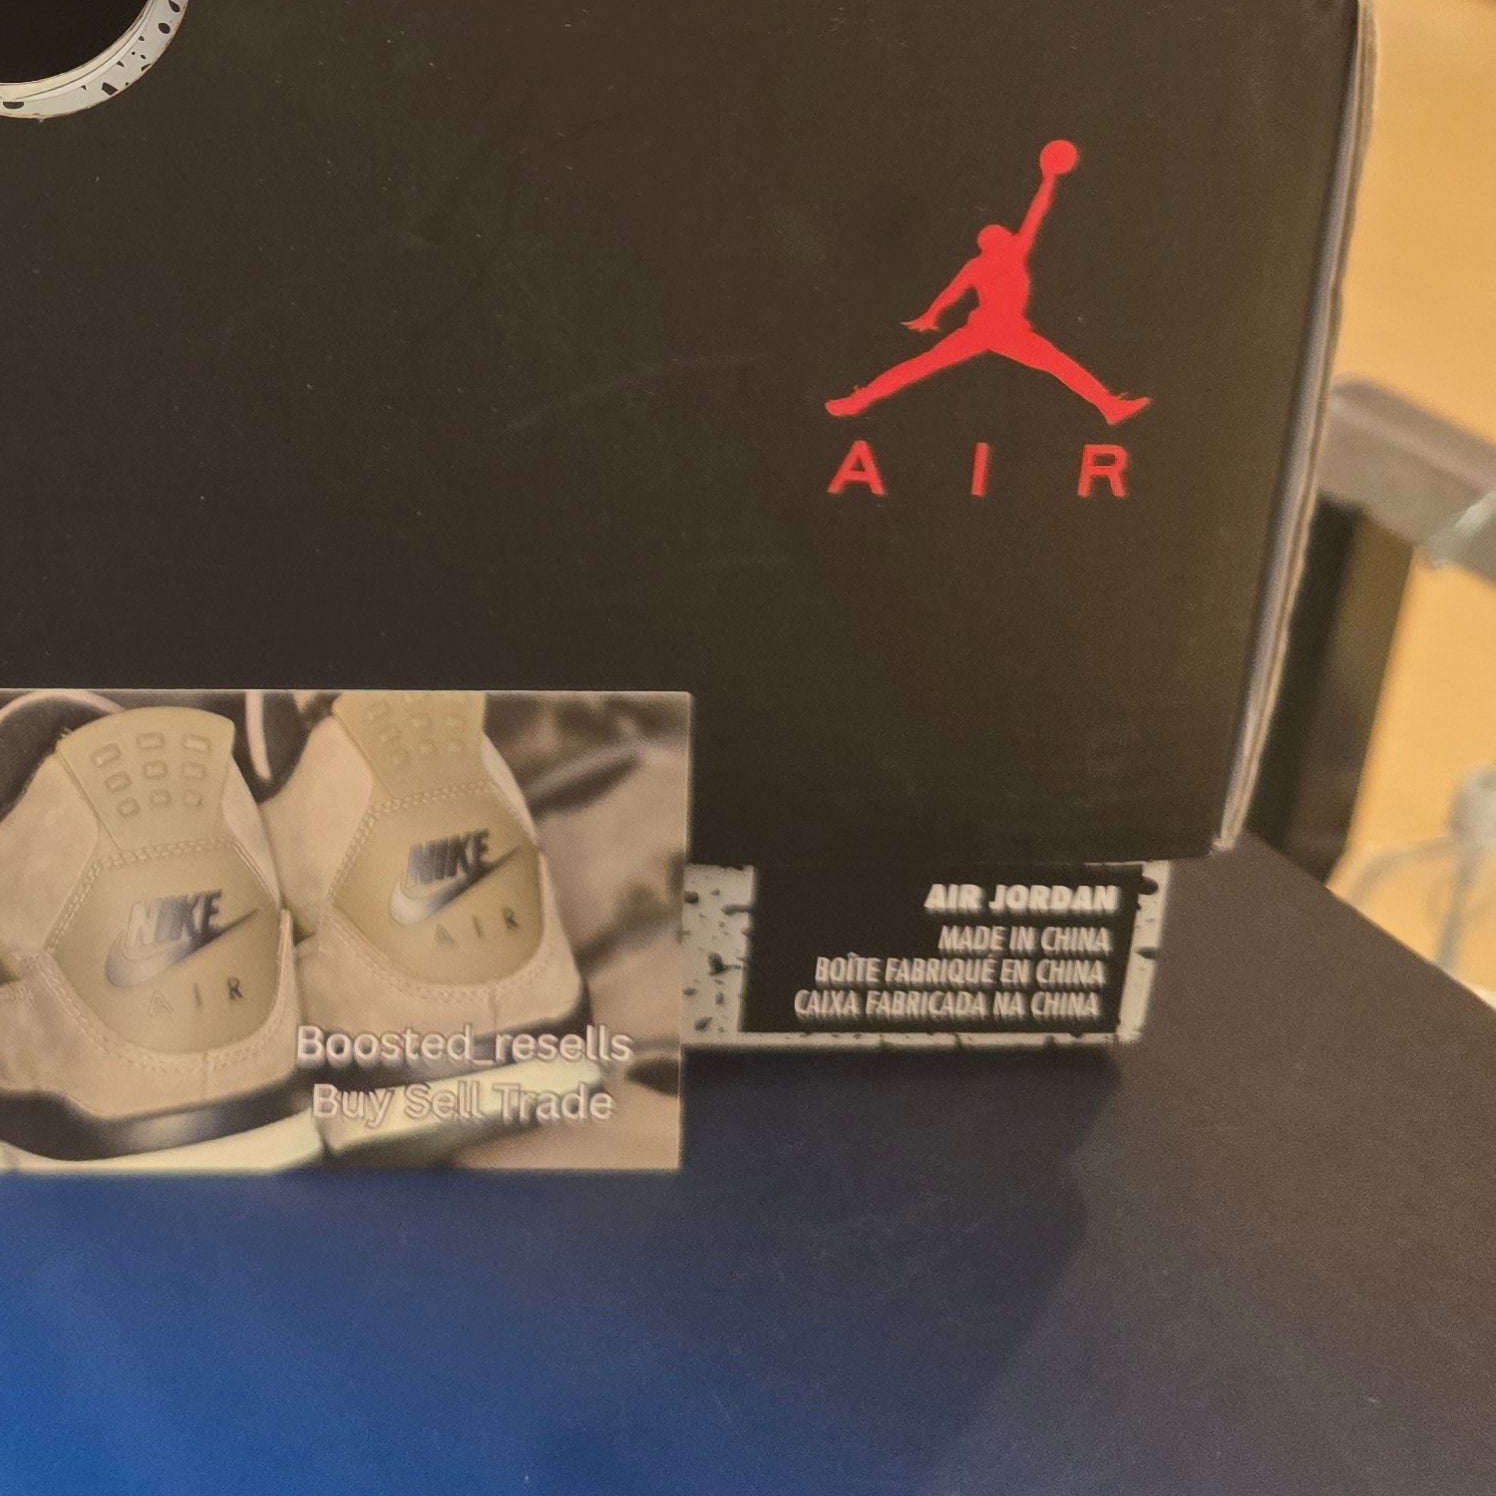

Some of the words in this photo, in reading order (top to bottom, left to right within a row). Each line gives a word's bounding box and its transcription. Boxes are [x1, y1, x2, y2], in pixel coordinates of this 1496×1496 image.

[826, 440, 1129, 498] AIR
[406, 827, 491, 890] NIKE
[923, 883, 984, 911] AIR
[988, 883, 1120, 913] JORDAN
[124, 888, 223, 952] NIKE
[938, 924, 1007, 952] MADE
[1008, 925, 1035, 952] IN
[1040, 926, 1112, 954] CHINA
[815, 951, 882, 984] BOÎTE
[1000, 958, 1032, 986] EN
[1035, 958, 1106, 987] CHINA
[794, 989, 860, 1018] CAIXA
[865, 989, 989, 1019] FABRICADA
[992, 991, 1026, 1020] NA
[1030, 991, 1102, 1021] CHINA
[296, 1024, 635, 1067] Boosted_resells
[311, 1082, 395, 1129] Buy
[404, 1080, 483, 1121] Sell
[491, 1082, 616, 1123] Trade
